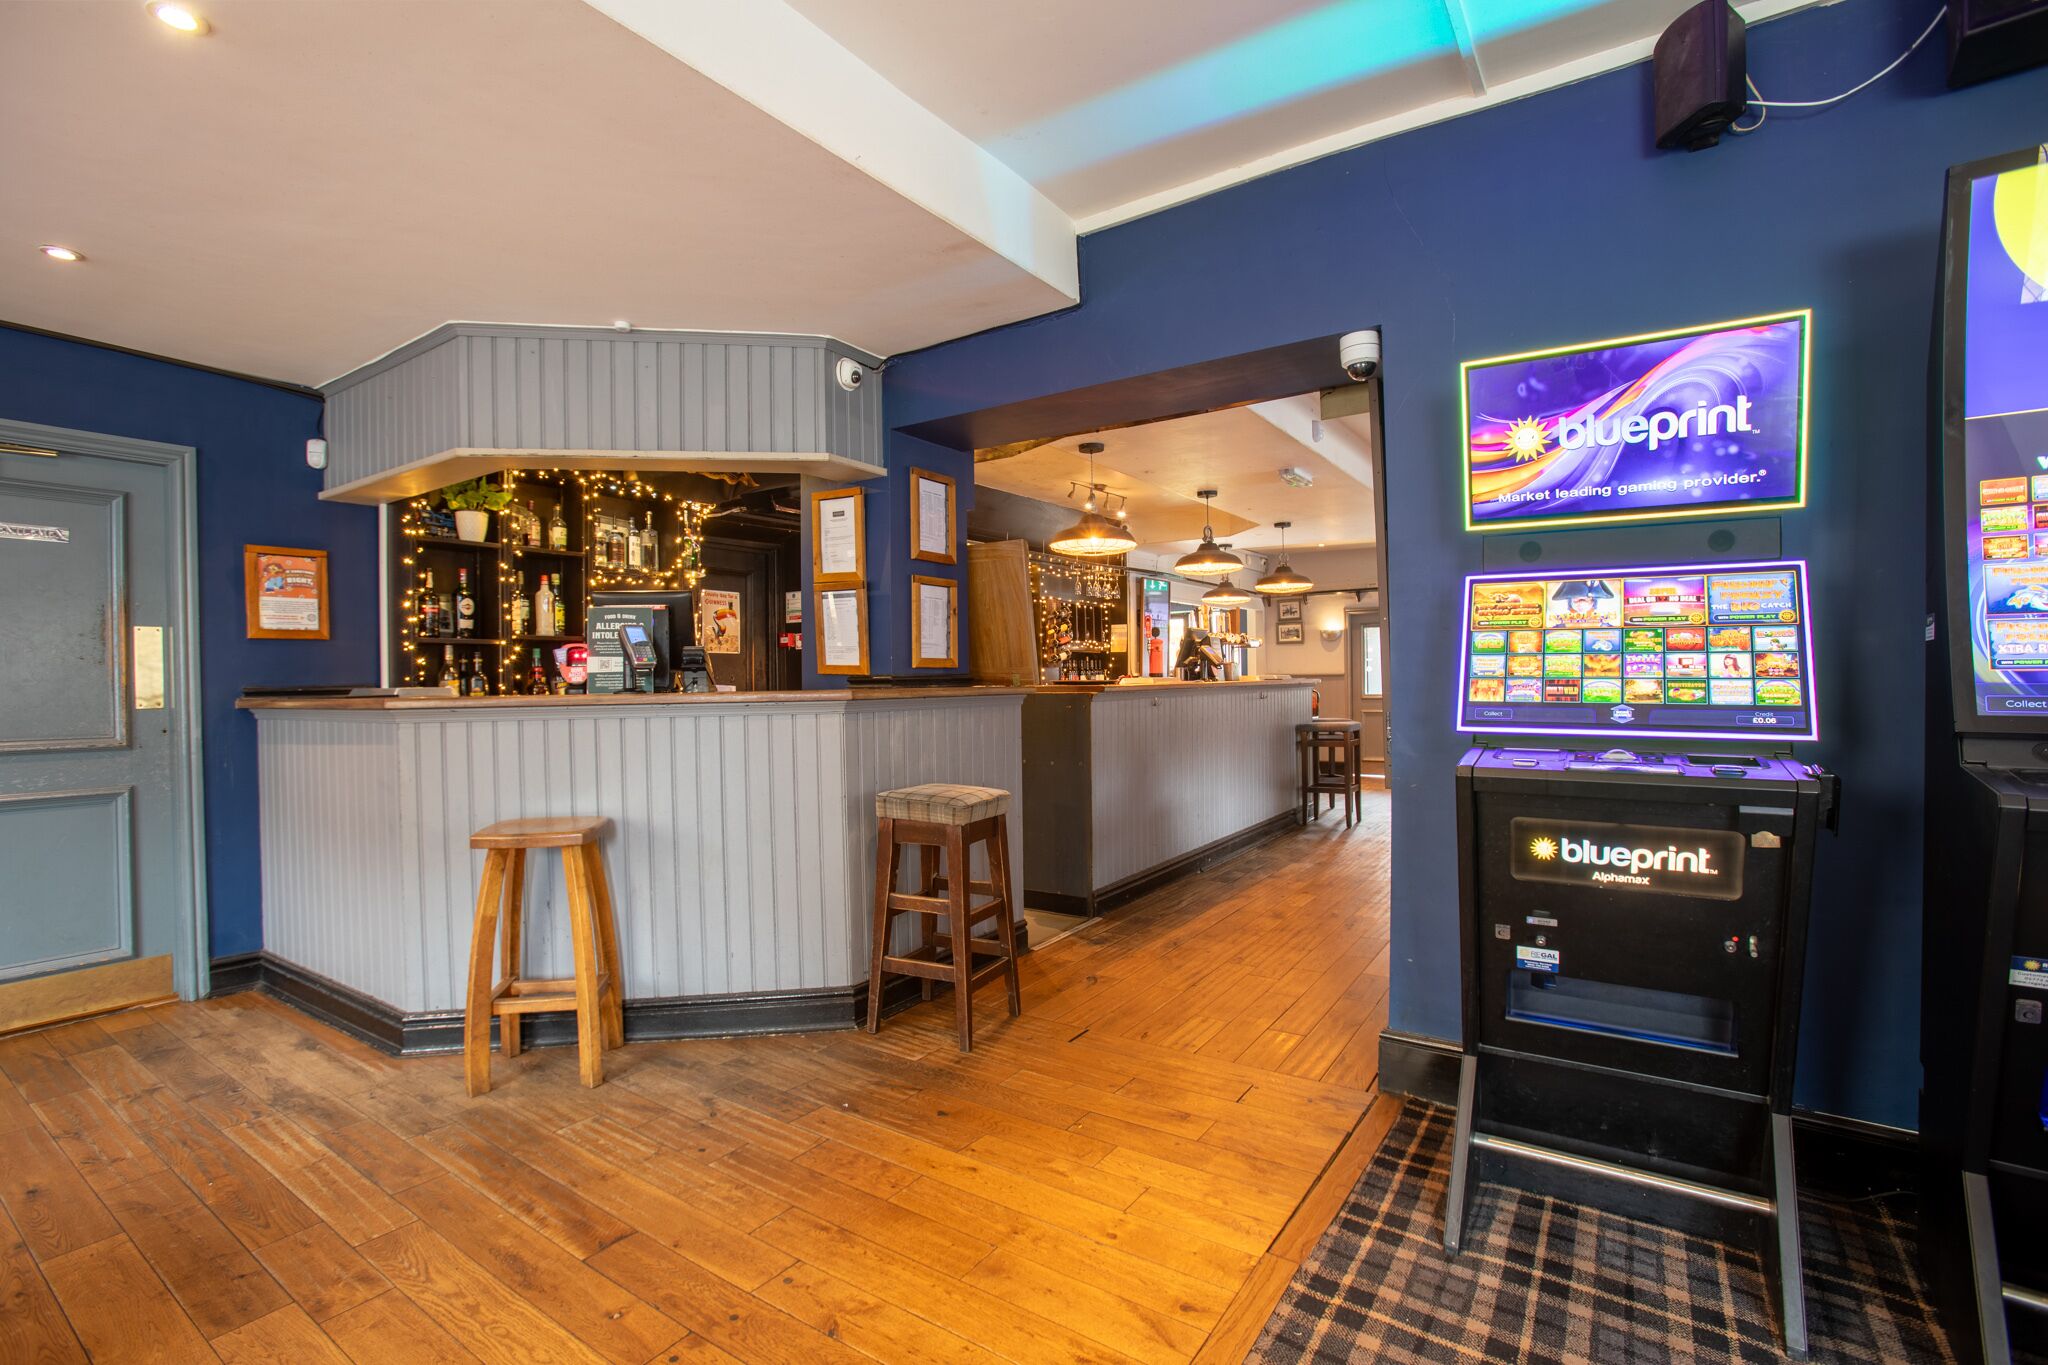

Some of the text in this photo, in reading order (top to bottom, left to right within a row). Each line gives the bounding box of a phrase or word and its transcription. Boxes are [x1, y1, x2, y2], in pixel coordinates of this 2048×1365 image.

[1557, 394, 1752, 451] blueprint
[1498, 489, 1551, 503] Market
[1555, 484, 1612, 501] leading
[1617, 479, 1677, 496] gaming
[1998, 643, 2033, 655] XTRA
[2006, 699, 2047, 708] Collect
[1560, 838, 1710, 874] blueprint
[1592, 871, 1650, 885] Alphamax
